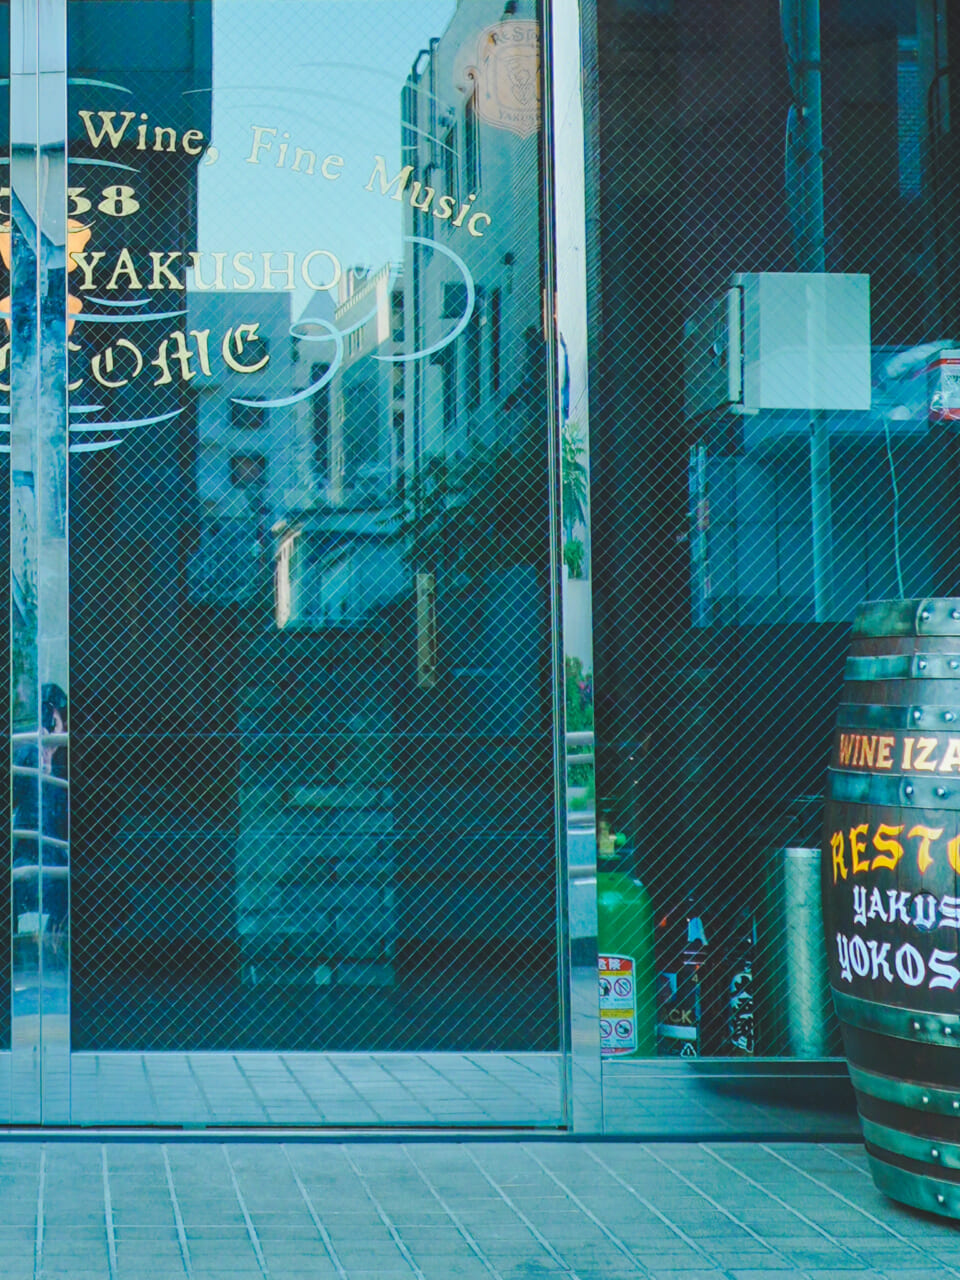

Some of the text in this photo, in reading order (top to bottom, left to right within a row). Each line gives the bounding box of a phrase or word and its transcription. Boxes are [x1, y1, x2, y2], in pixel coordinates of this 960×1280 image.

[77, 110, 220, 166] Wine,
[246, 124, 345, 180] Fine
[364, 154, 492, 237] Music
[69, 247, 343, 292] YAKUSHO
[839, 733, 896, 769] WINE
[836, 932, 960, 991] YOKOS
